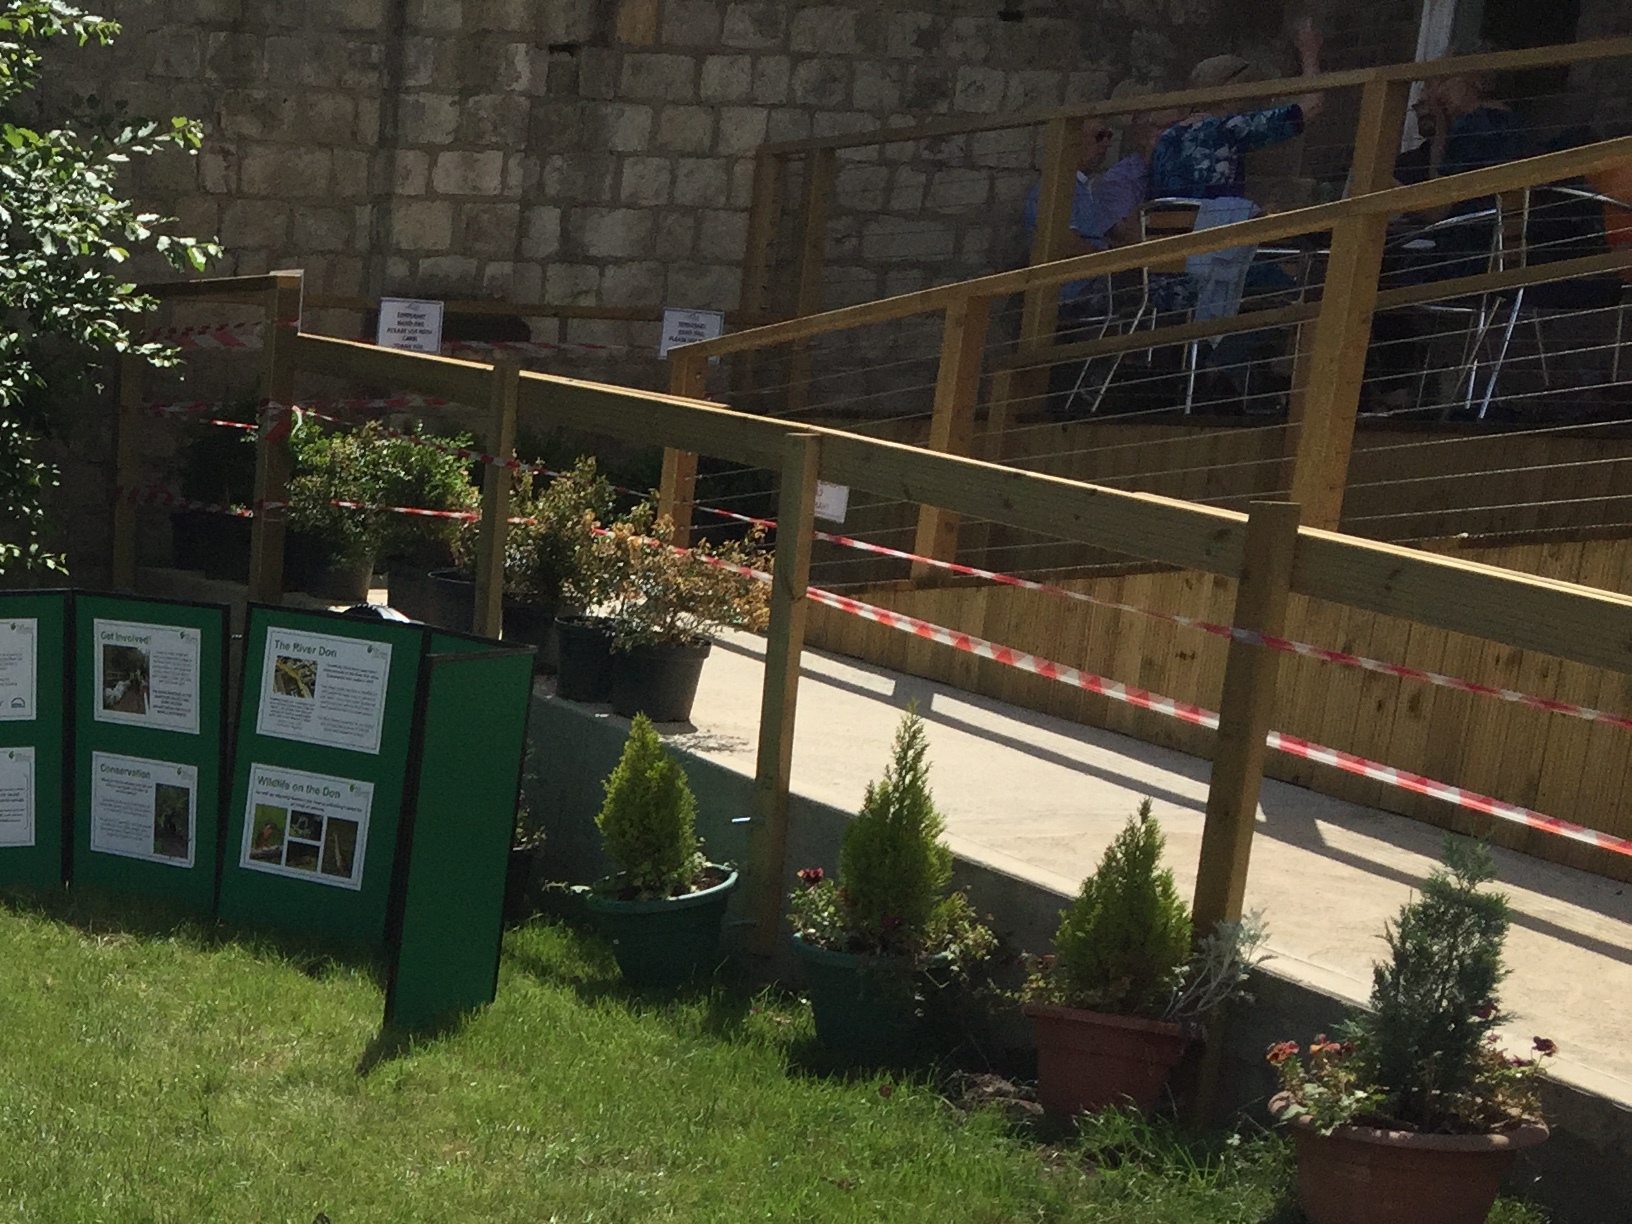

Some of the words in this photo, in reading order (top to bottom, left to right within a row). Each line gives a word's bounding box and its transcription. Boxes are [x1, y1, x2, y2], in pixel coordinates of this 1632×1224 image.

[101, 631, 113, 640] Get
[275, 640, 290, 650] The
[293, 642, 317, 655] River
[319, 646, 337, 658] Don
[101, 763, 151, 779] Conservation
[258, 775, 290, 791] Wildlife
[292, 783, 304, 791] on
[306, 785, 320, 795] the
[323, 787, 341, 798] Don
